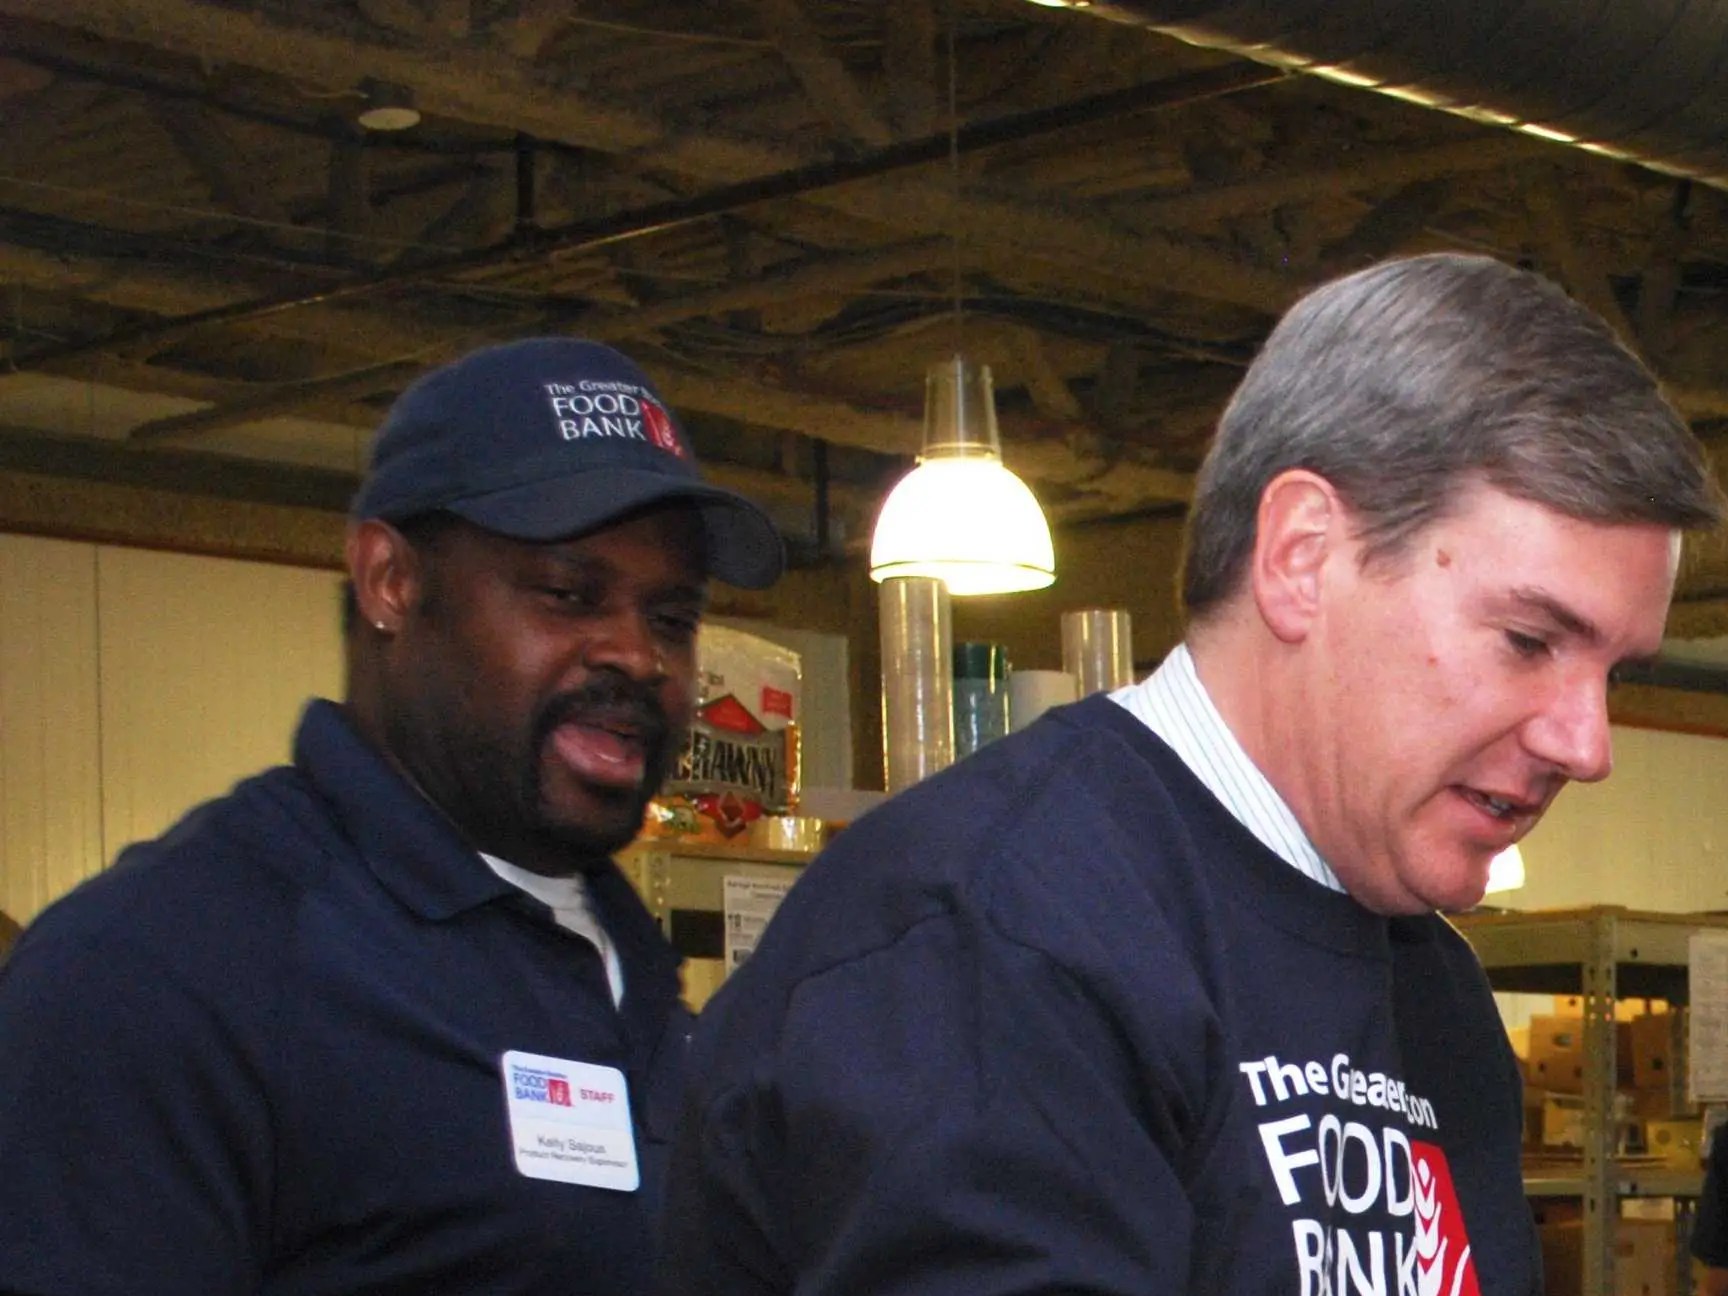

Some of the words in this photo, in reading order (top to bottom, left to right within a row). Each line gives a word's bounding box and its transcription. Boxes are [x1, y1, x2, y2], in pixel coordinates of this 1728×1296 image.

[544, 383, 575, 395] The
[578, 380, 639, 394] Greater
[552, 394, 640, 417] FOOD
[560, 416, 647, 440] BANK
[513, 1073, 547, 1089] FOOD
[1239, 1055, 1330, 1106] The
[514, 1086, 547, 1103] BANK
[579, 1088, 615, 1104] STAFF
[1258, 1113, 1412, 1216] FOOD
